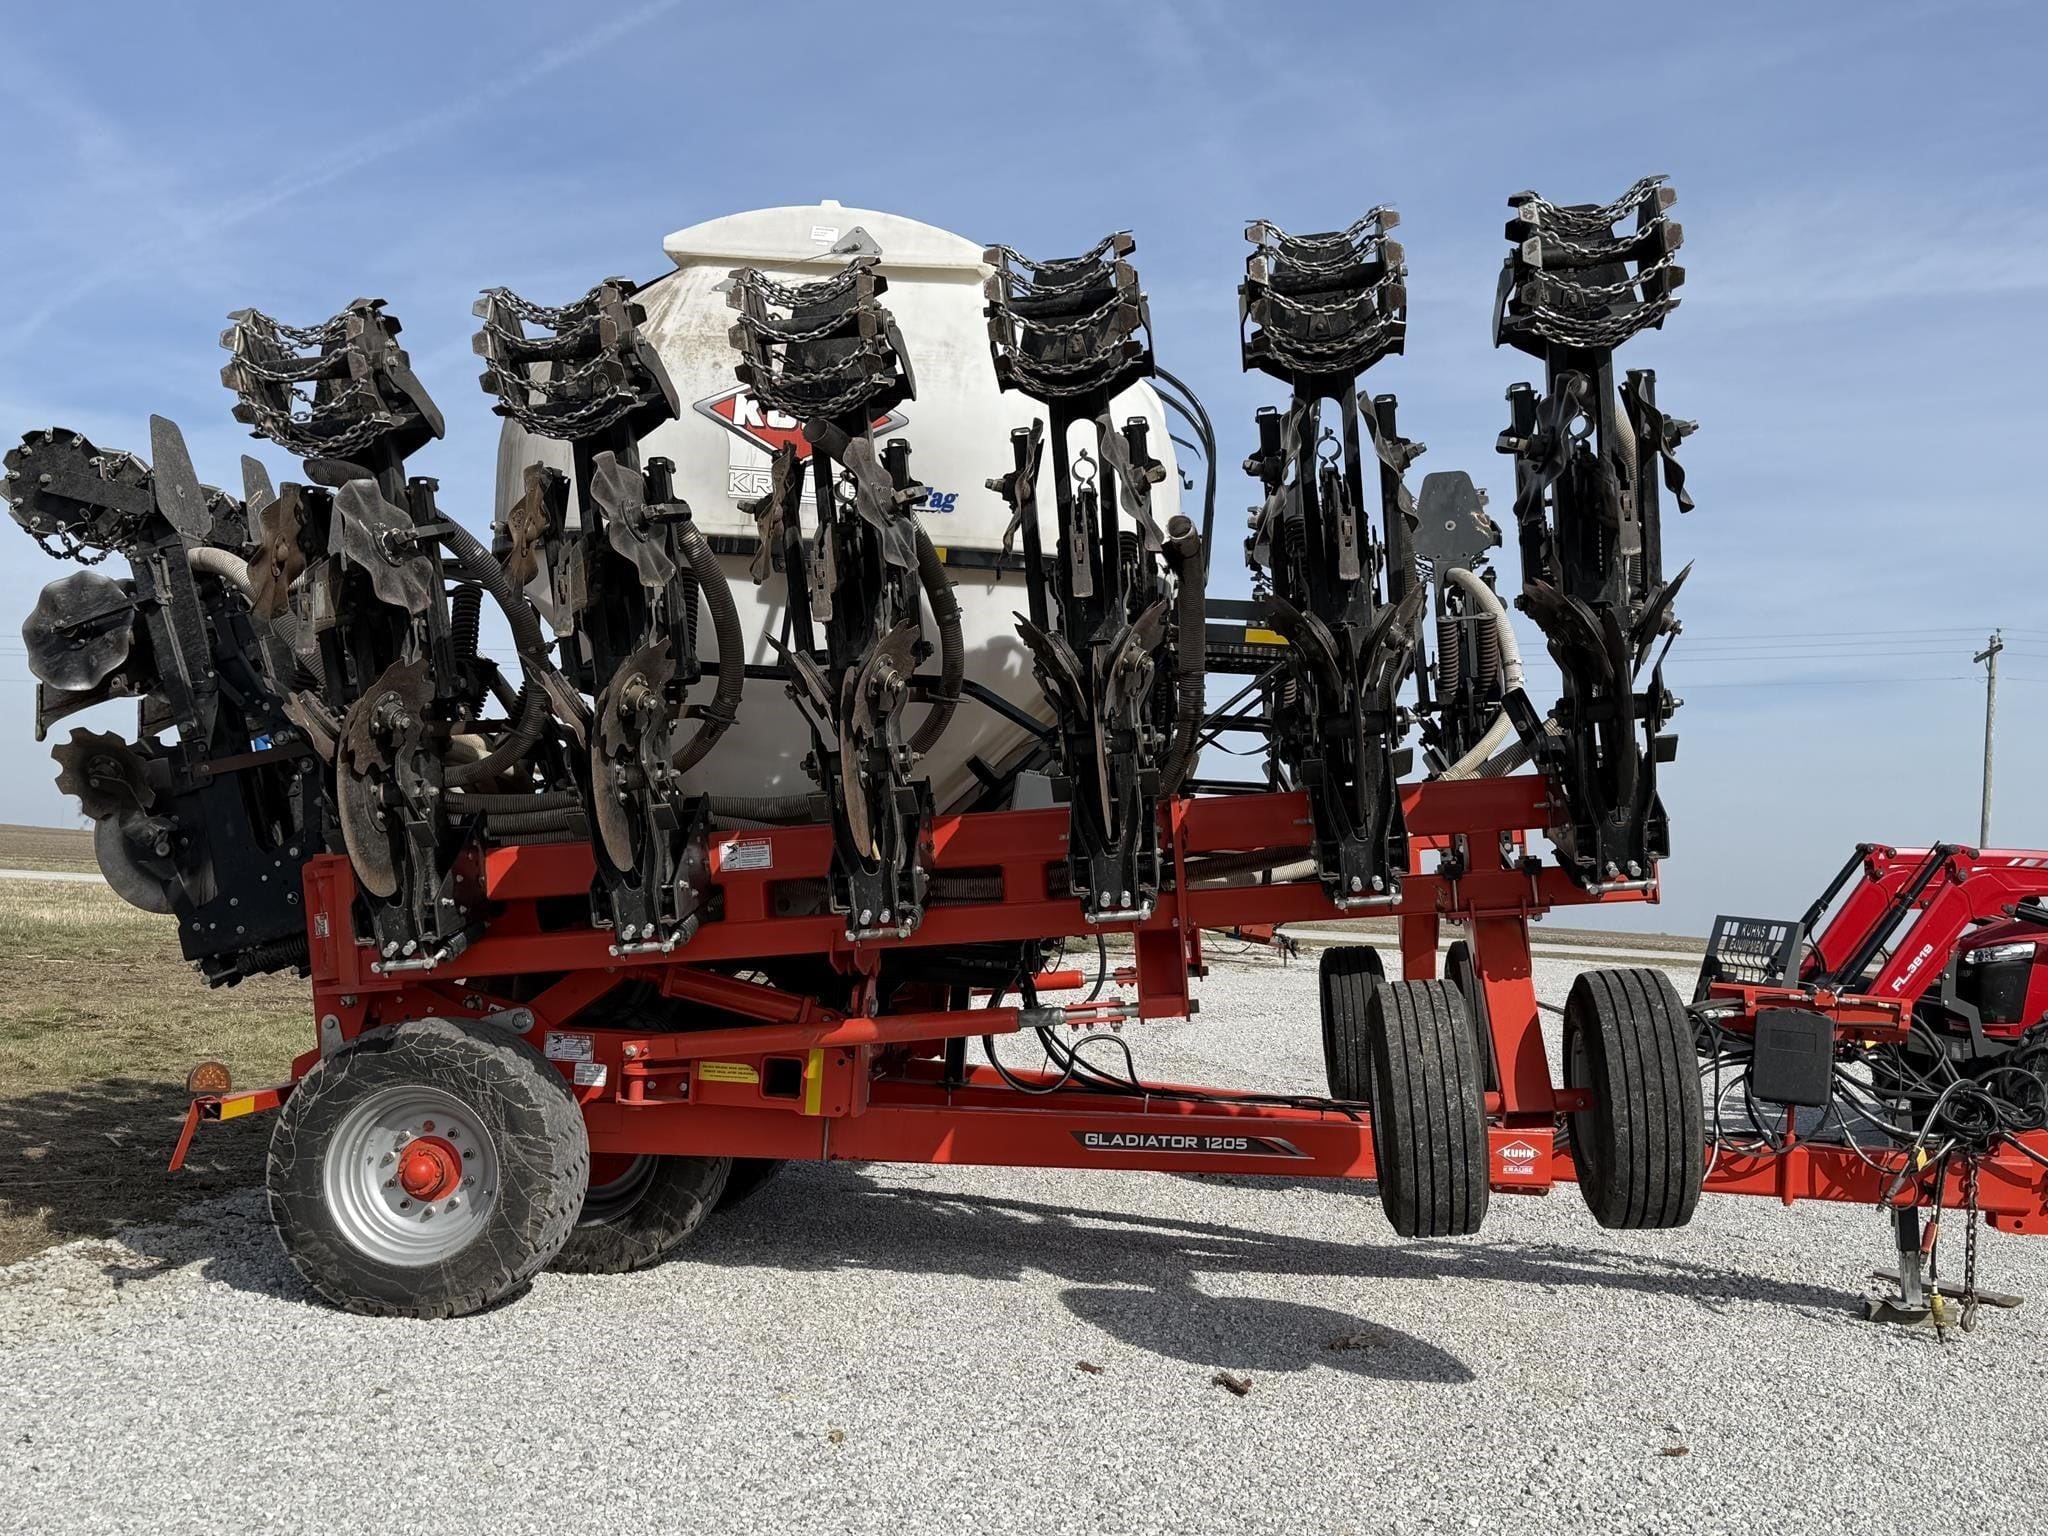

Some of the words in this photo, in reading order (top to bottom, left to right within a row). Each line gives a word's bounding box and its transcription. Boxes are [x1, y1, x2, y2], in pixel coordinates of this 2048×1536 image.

[1084, 1133, 1199, 1149] GLADIATOR
[1204, 1136, 1248, 1150] 1205
[1503, 1148, 1535, 1158] KUHN
